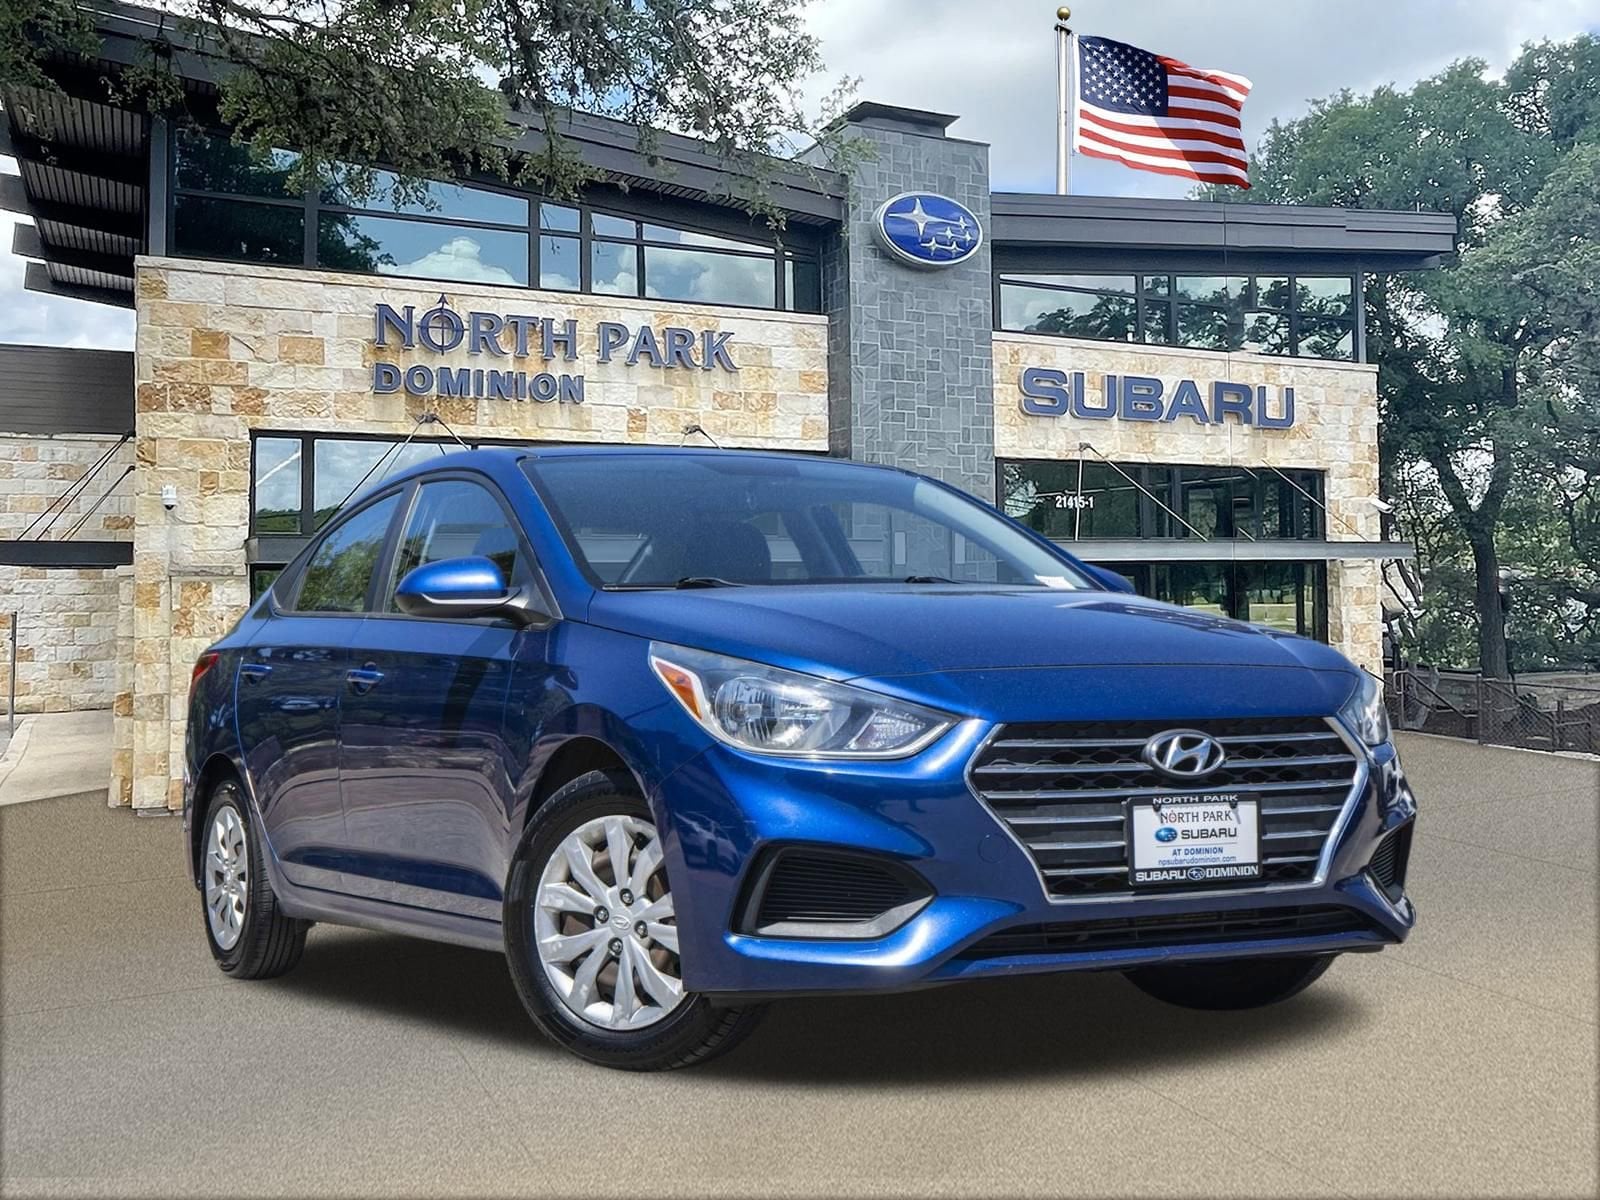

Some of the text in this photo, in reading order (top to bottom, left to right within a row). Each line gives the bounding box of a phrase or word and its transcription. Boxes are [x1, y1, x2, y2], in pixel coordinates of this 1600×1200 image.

[374, 296, 740, 373] NORTH PARK
[373, 362, 585, 404] DOMINION
[1019, 367, 1295, 429] SUBARU
[1152, 794, 1239, 805] NORTH PARK
[1160, 810, 1233, 824] NORTH PARK
[1181, 827, 1238, 840] SUBARU
[1184, 846, 1224, 855] DOMINION
[1158, 855, 1237, 866] npsubarudominion.com
[1135, 865, 1259, 882] SUBARU DOMINION
